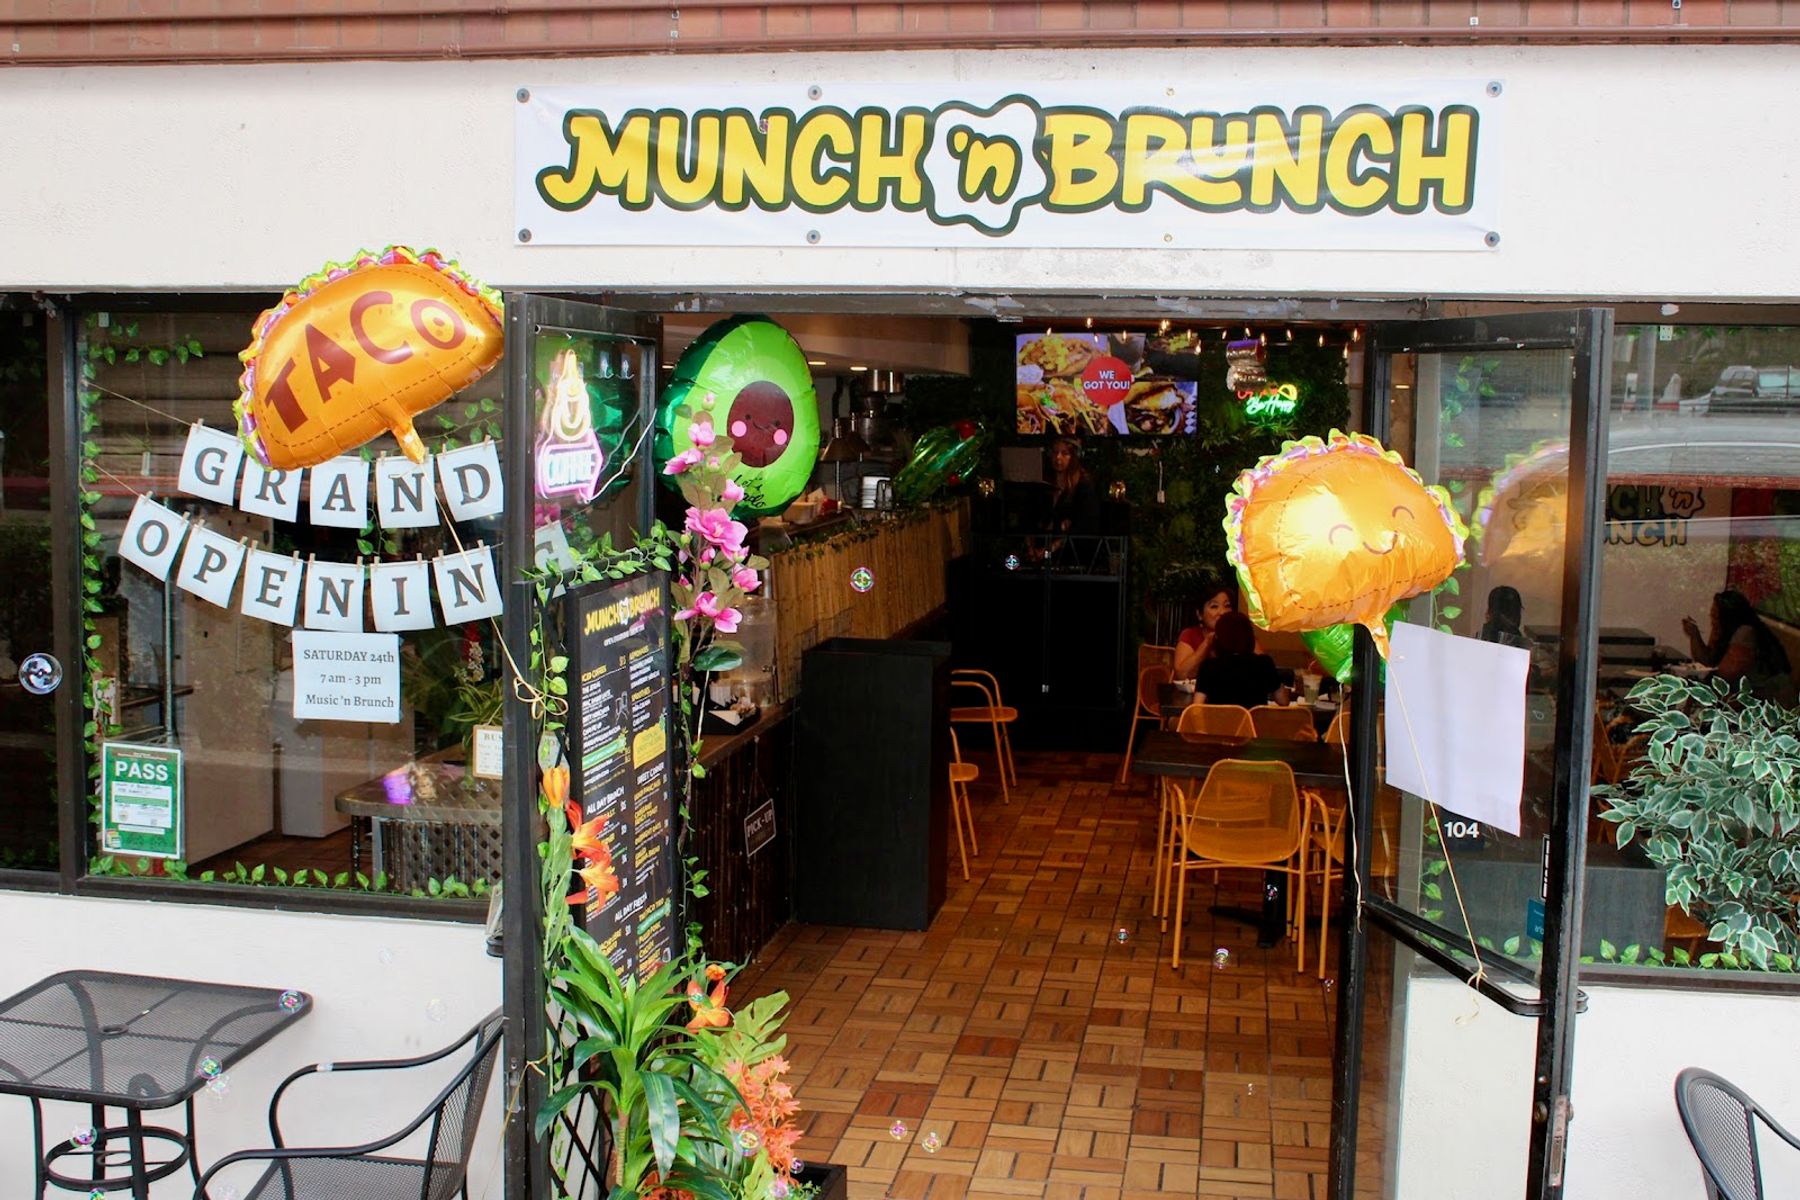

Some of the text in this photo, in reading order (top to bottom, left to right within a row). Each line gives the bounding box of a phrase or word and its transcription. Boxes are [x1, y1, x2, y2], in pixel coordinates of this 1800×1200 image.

[536, 104, 1481, 214] MUNCH 'n BRUNCH
[264, 290, 467, 434] TACO
[1099, 370, 1115, 379] WE
[1083, 380, 1130, 390] GOT YOU!
[193, 446, 492, 513] GRAND
[1603, 518, 1687, 547] NCH
[584, 602, 620, 636] MUNCH
[629, 587, 660, 618] BRUNCH
[303, 649, 395, 663] SATURDAY 24th
[320, 674, 326, 683] 7
[328, 675, 346, 684] am
[355, 675, 361, 685] 3
[363, 676, 382, 687] pm
[305, 694, 395, 708] Music 'n Brunch
[115, 760, 168, 781] PASS
[587, 803, 596, 815] ALL
[747, 809, 772, 838] PICK-UP
[1444, 821, 1479, 838] 104
